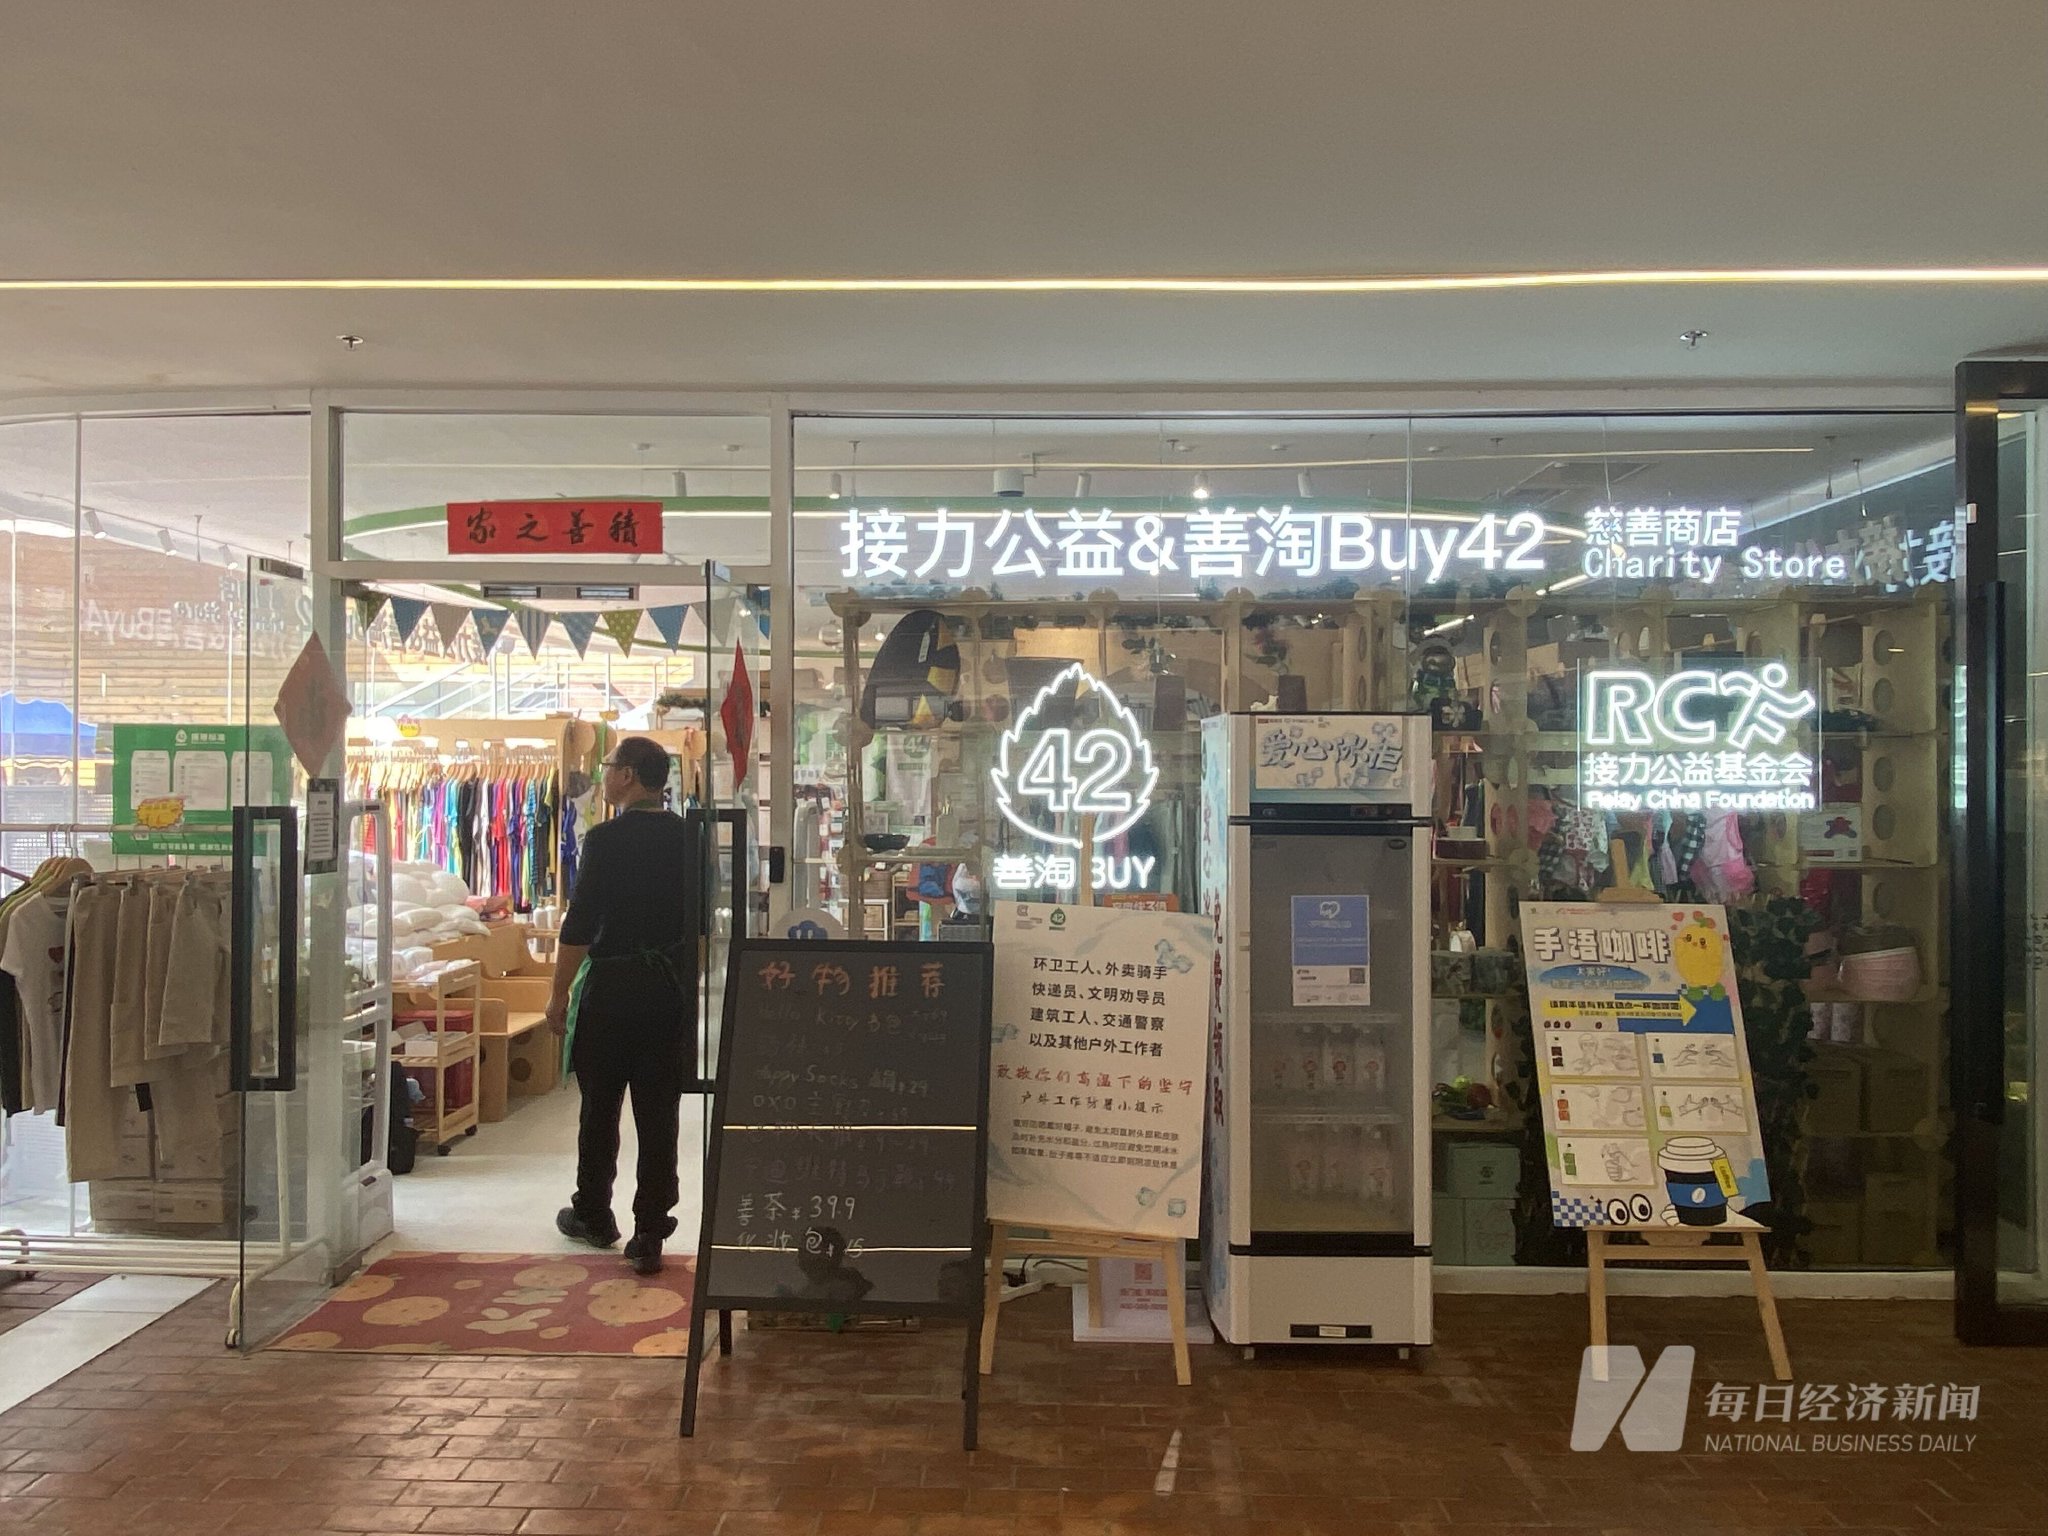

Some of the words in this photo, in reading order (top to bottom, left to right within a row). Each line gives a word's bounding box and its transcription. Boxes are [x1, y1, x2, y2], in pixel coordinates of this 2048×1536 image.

[839, 506, 1546, 583] 接力公益&善淘Buy42
[1583, 506, 1743, 548] 慈善商店
[1583, 547, 1722, 584] Charity
[1744, 546, 1846, 580] Store
[1018, 727, 1133, 813] 42
[1583, 752, 1812, 787] 接力公益基金会
[1587, 790, 1641, 811] Relay
[1647, 789, 1701, 809] China
[1705, 788, 1815, 810] Foundation
[992, 854, 1076, 890] 善淘
[1533, 927, 1671, 963] 手语咖啡
[758, 960, 946, 999] 好物推荐
[1033, 957, 1169, 980] 环卫工人、外卖骑手
[1031, 982, 1167, 1006] 快递员、文明劝导员
[1030, 1007, 1166, 1032] 建筑工人、交通警察
[1029, 1033, 1164, 1057] 以及其他户外工作者
[996, 1064, 1194, 1096] 致敬你们高温下的坚守
